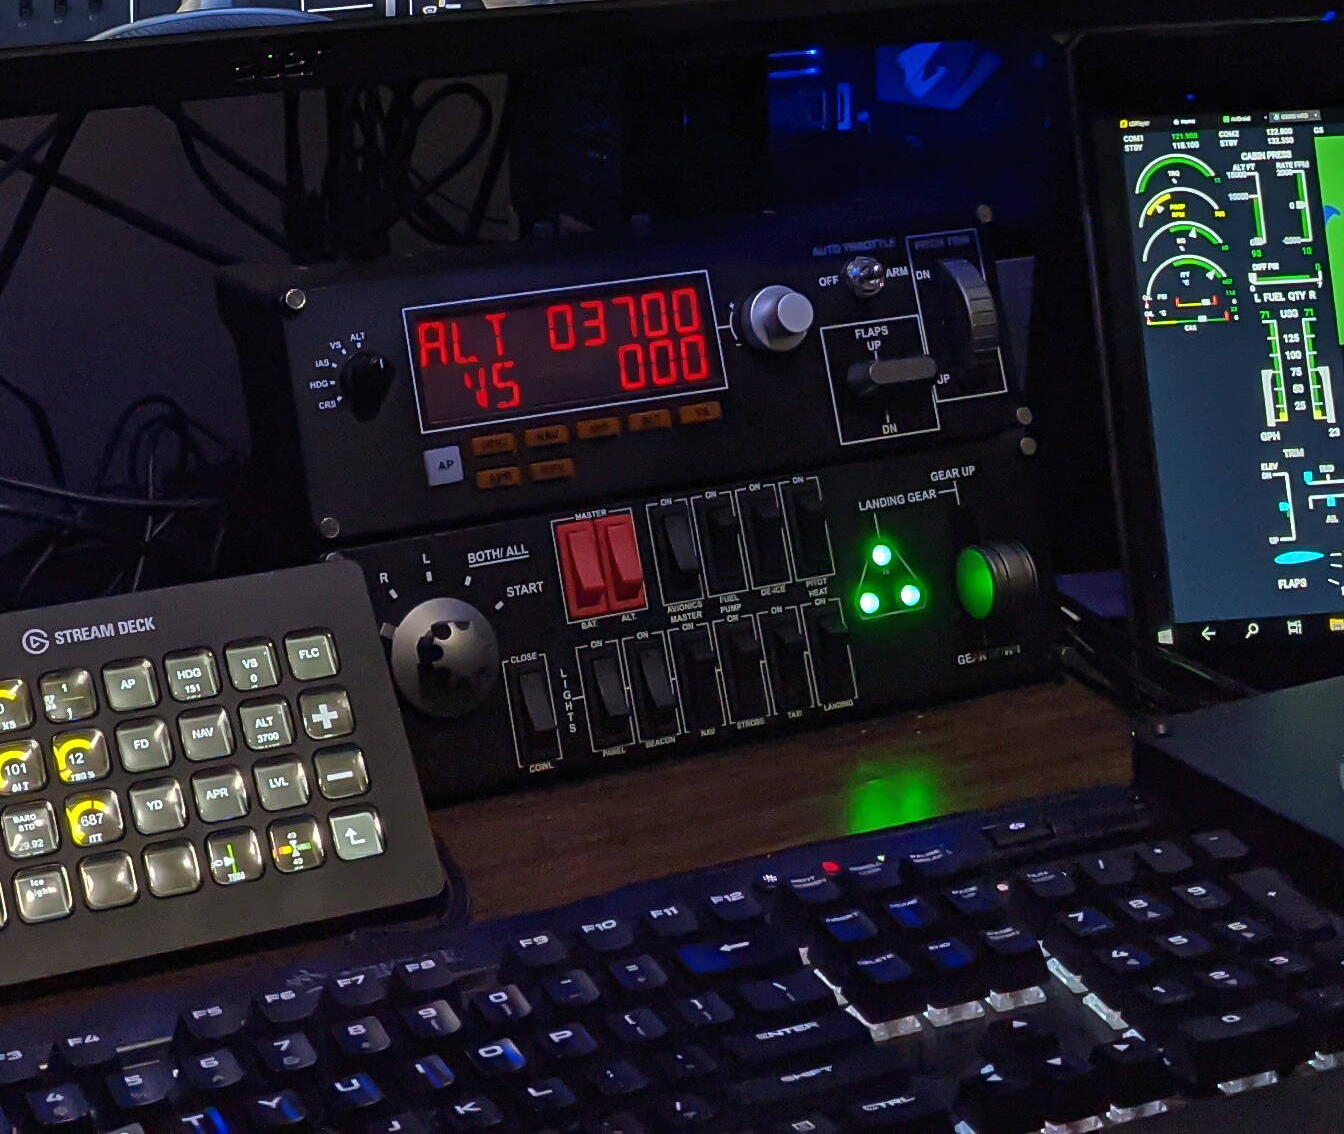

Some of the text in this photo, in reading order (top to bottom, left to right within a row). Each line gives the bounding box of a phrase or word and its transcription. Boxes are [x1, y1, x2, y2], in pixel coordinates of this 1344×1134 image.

[818, 274, 840, 288] OFF
[417, 287, 701, 368] ALT 03700
[856, 324, 890, 338] FLAPS
[930, 465, 976, 482] GEAR UP
[859, 489, 937, 512] LANDING GEAR
[575, 508, 607, 522] MASTER
[506, 580, 544, 597] START
[1278, 578, 1307, 589] FLAPS
[54, 617, 156, 646] STREAM DECK
[299, 646, 320, 660] FLC
[510, 652, 537, 664] CLOSE
[177, 668, 202, 682] HDG
[192, 727, 215, 739] NAV
[4, 763, 28, 777] 101
[80, 812, 104, 827] 687
[709, 891, 745, 908] F12
[650, 906, 679, 920] F11
[582, 919, 617, 937] F10
[756, 1021, 820, 1042] ENTER
